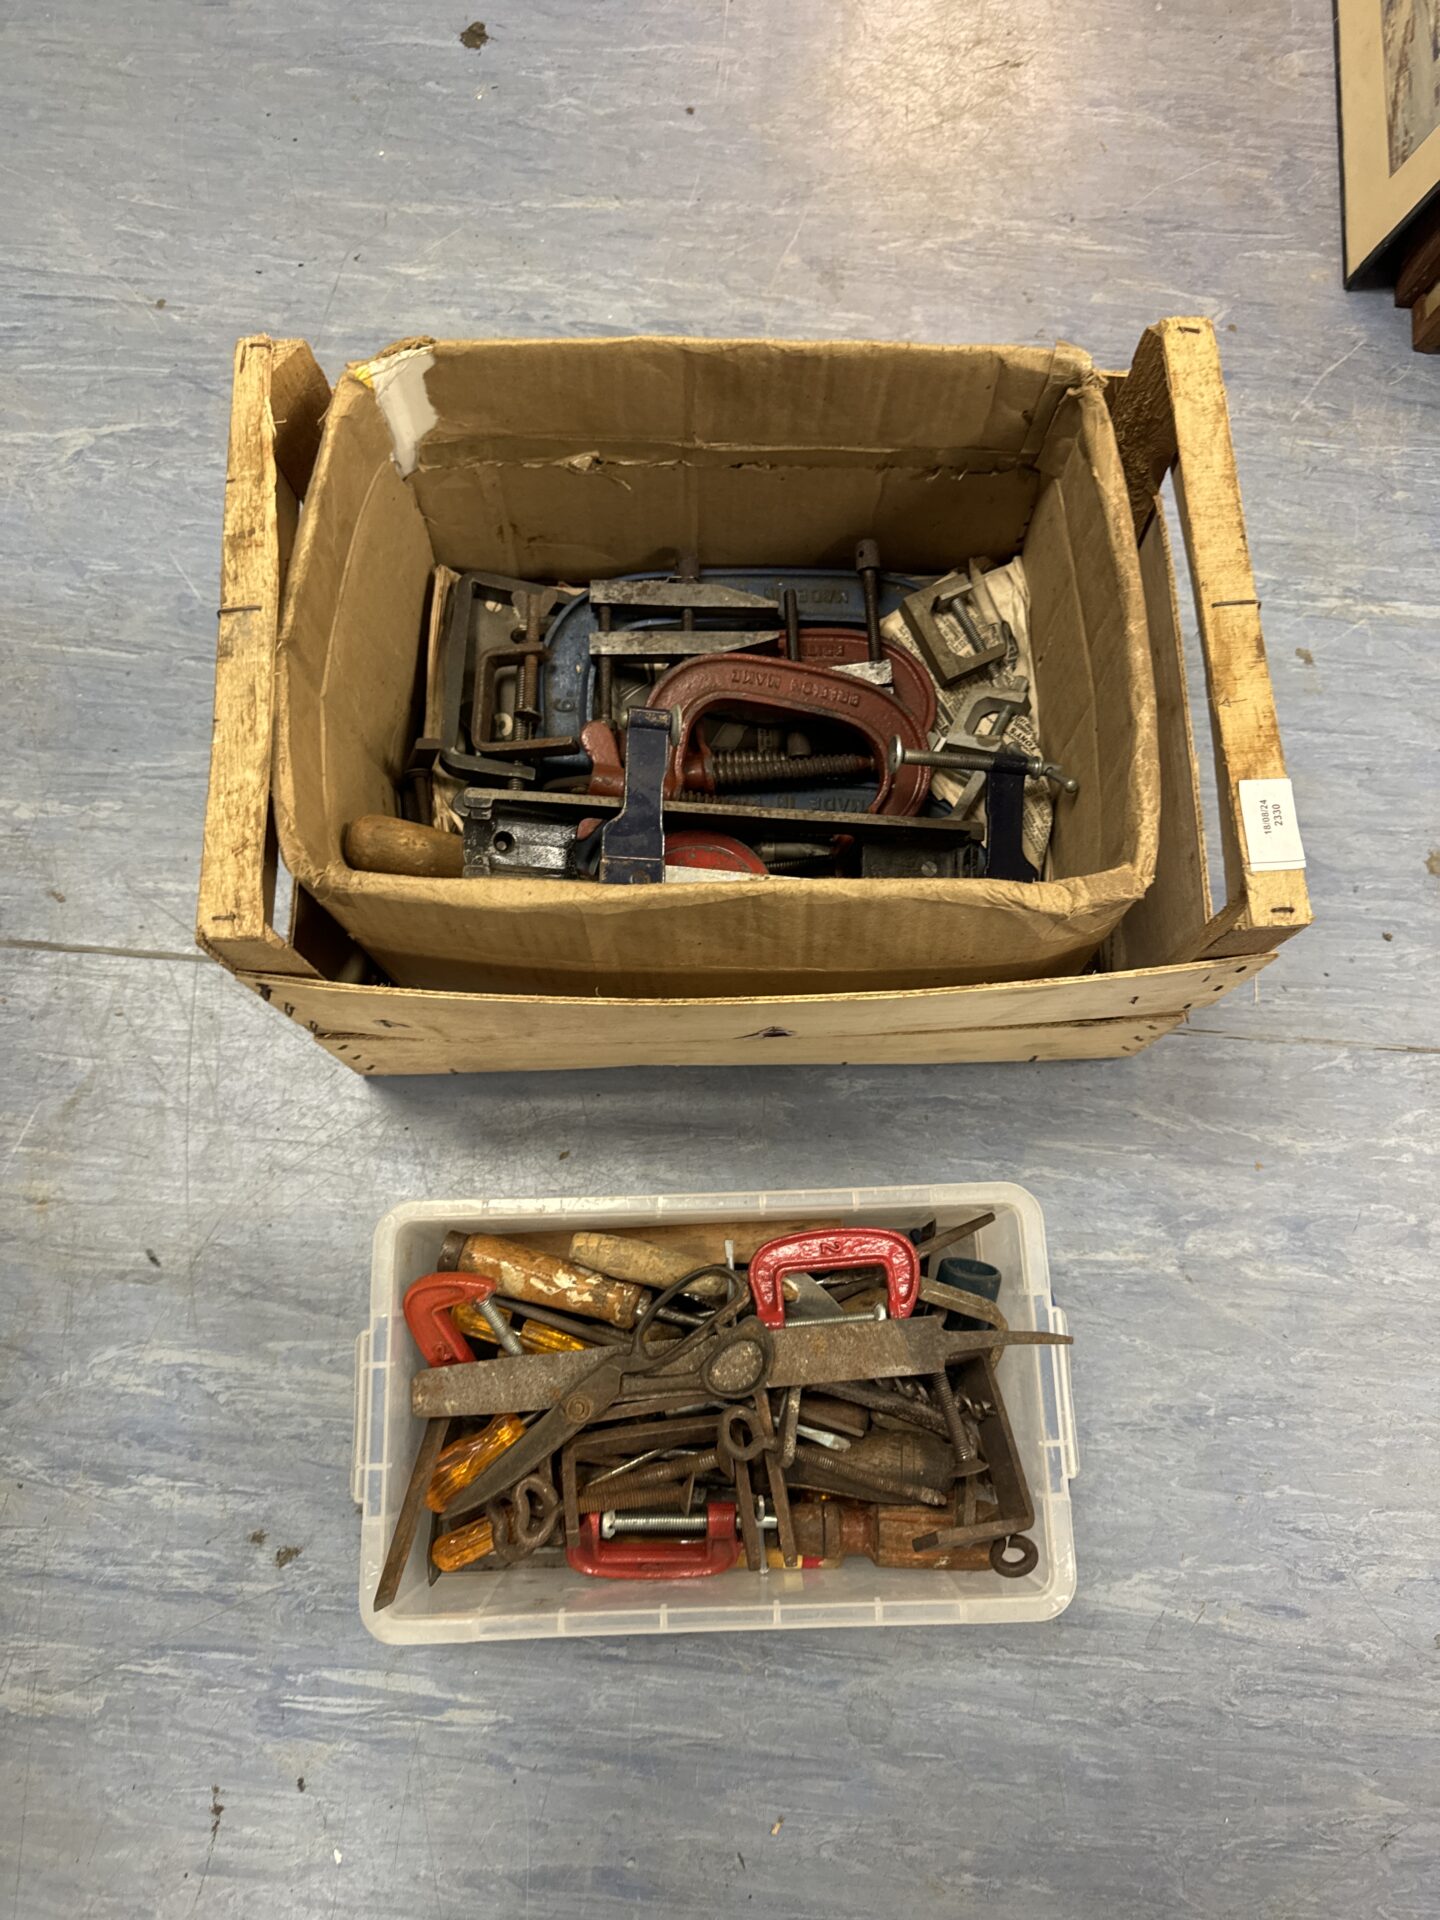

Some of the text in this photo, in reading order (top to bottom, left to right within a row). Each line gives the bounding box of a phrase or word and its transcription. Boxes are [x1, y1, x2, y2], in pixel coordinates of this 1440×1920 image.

[731, 669, 781, 690] MAKE
[1260, 799, 1272, 834] 18/08/24
[1272, 804, 1283, 826] 2330
